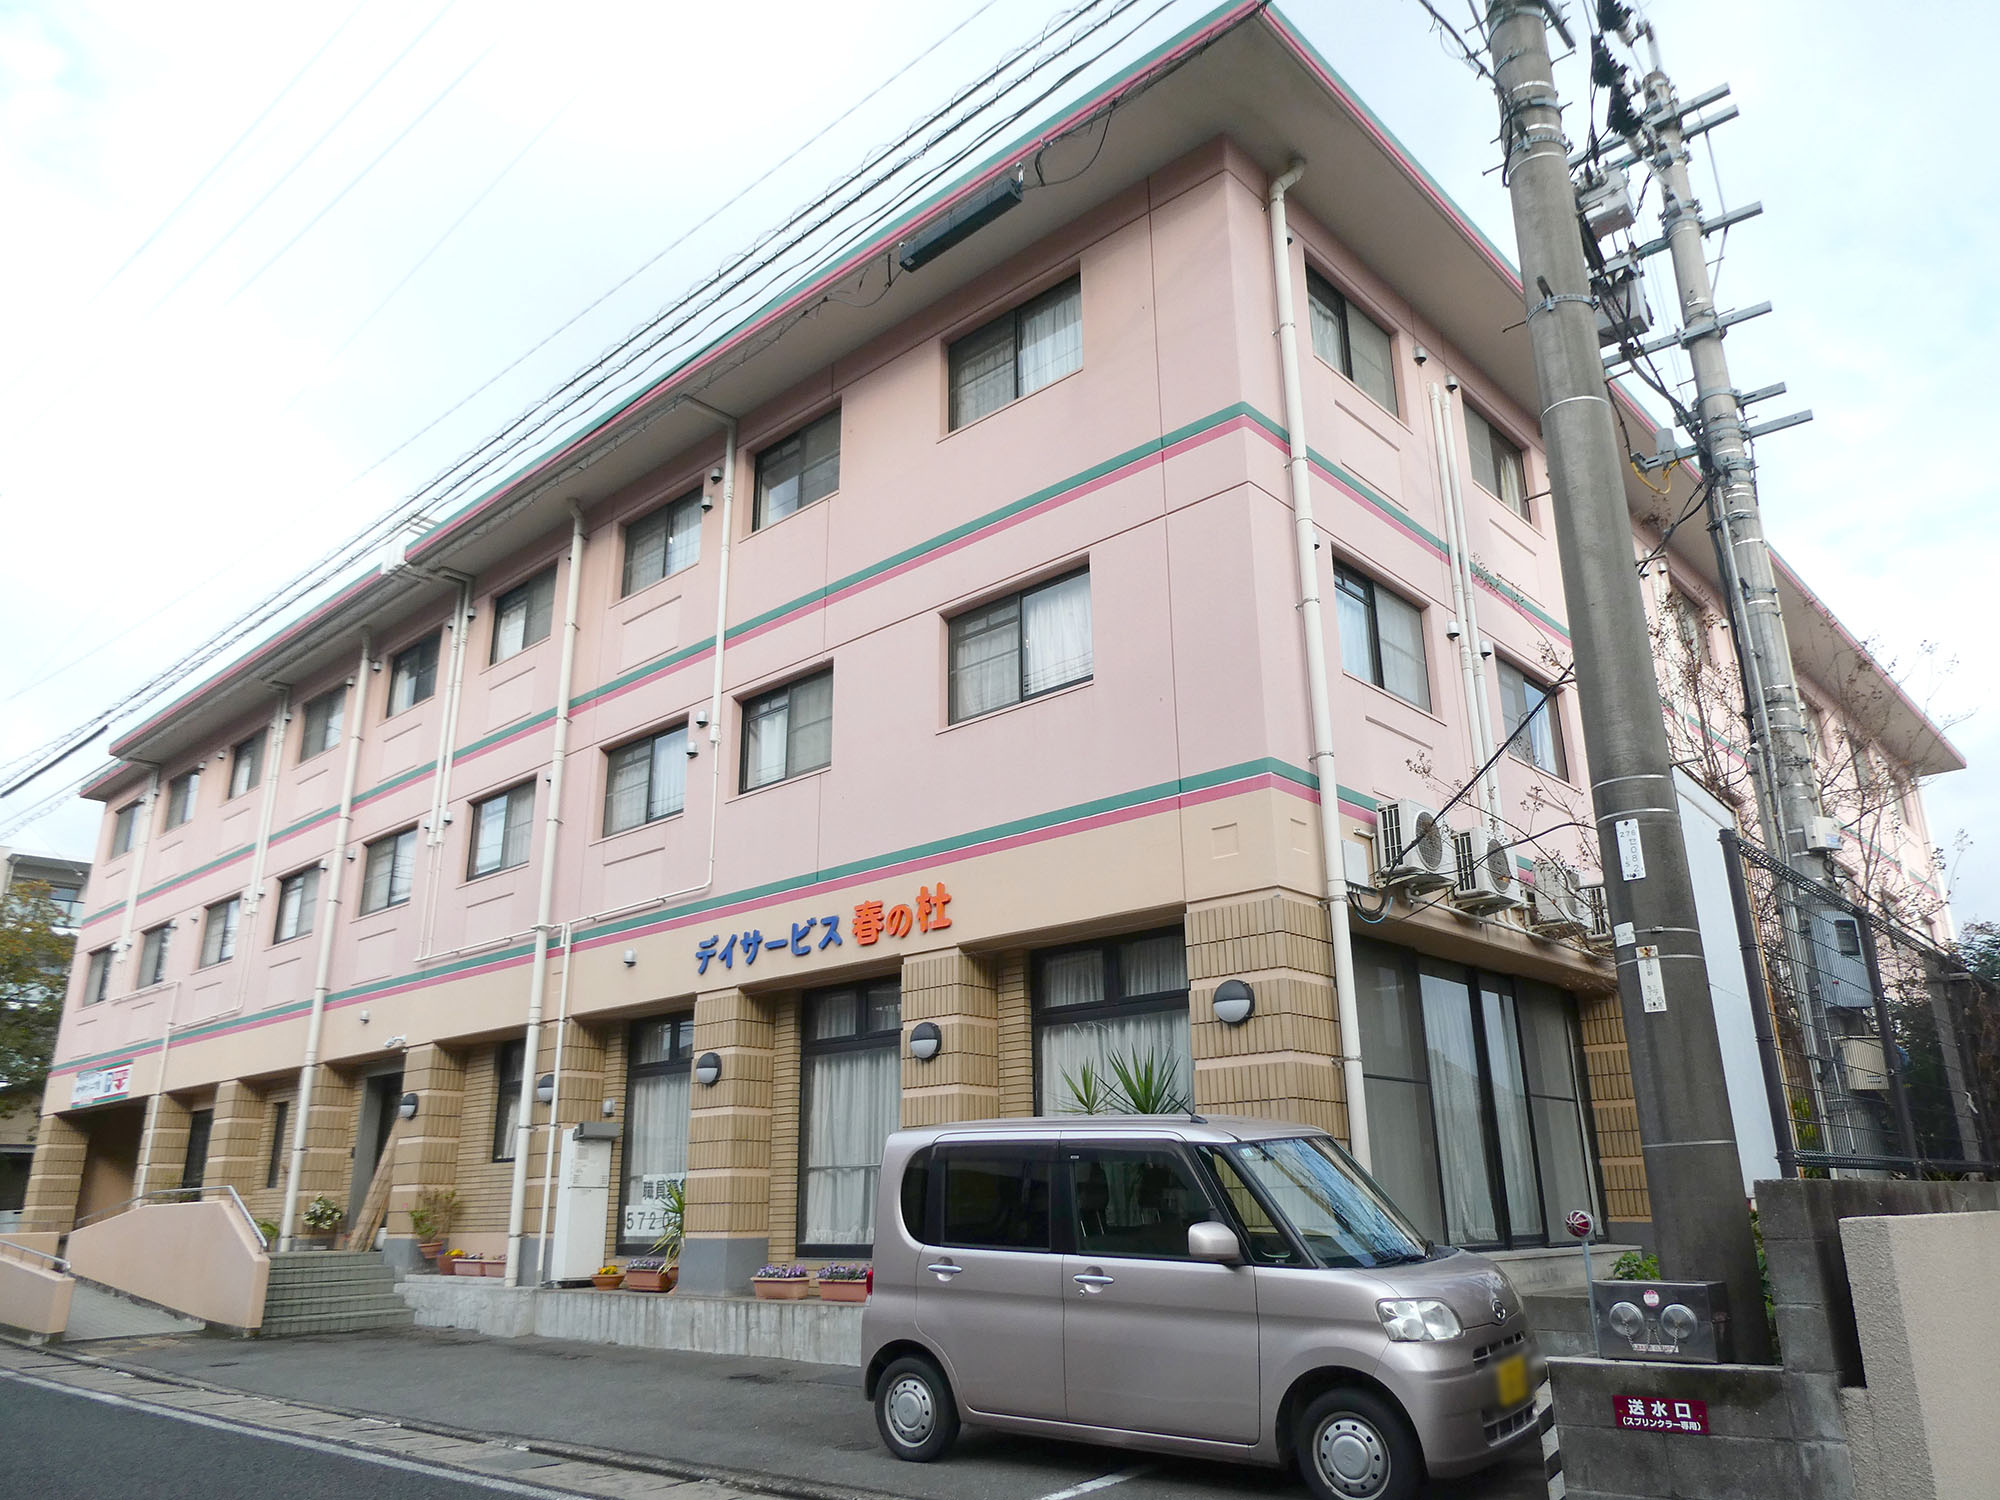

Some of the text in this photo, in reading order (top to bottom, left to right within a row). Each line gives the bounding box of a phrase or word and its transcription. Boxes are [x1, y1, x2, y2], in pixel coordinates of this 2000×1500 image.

[695, 881, 952, 976] デイサービス 春の杜
[1627, 1399, 1692, 1419] 送水口
